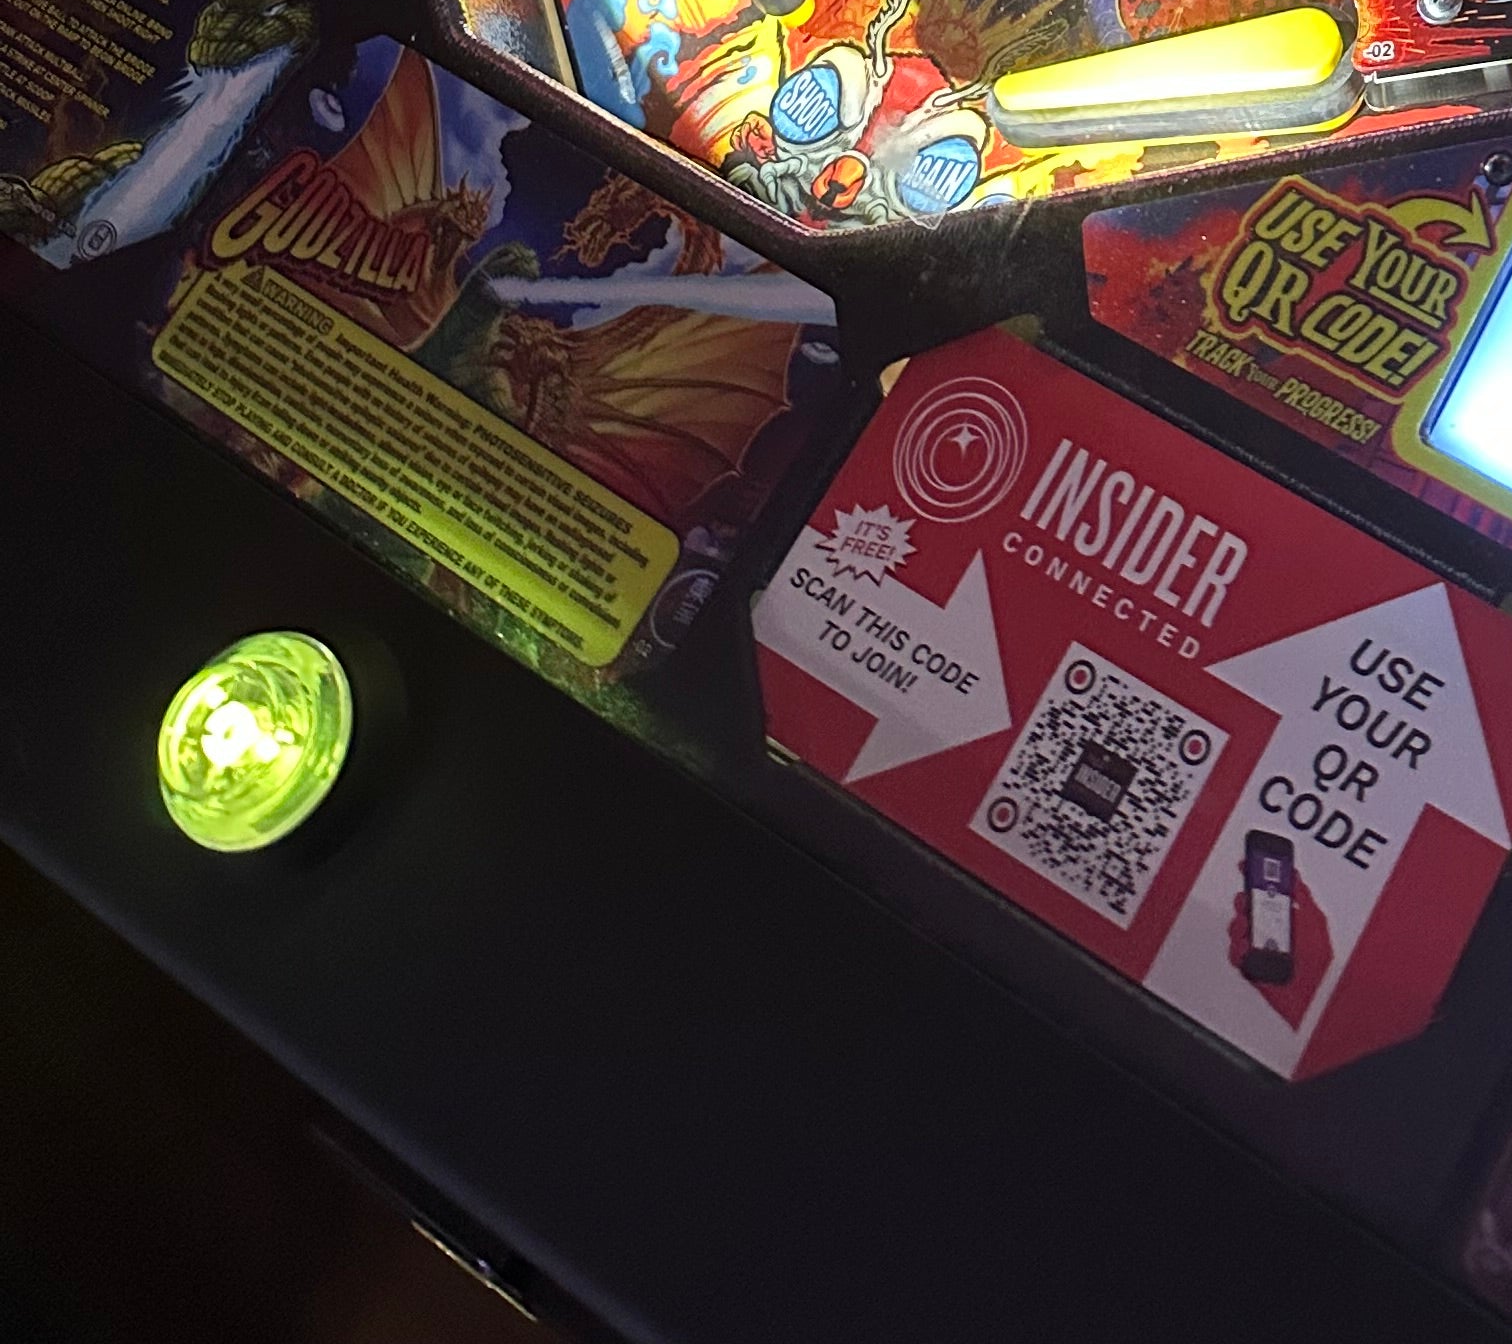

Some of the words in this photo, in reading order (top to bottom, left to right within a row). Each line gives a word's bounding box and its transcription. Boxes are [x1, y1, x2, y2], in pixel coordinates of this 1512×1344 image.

[1366, 44, 1392, 58] -02
[780, 70, 837, 138] SHOOT
[903, 154, 978, 202] AGAIN
[211, 149, 435, 292] GODZILLA
[1254, 193, 1355, 269] USE
[1346, 219, 1458, 320] YOUR
[260, 278, 335, 336] WARNING
[1222, 241, 1308, 337] QR
[1301, 295, 1440, 385] CODE!
[1186, 331, 1250, 376] TRACK
[1275, 377, 1382, 444] PROGRESS!
[334, 332, 389, 375] Important
[386, 365, 426, 399] Health
[472, 420, 574, 499] PHOTOSENSITIVE
[572, 487, 634, 536] SEIZURES
[405, 519, 465, 567] EXPERIENCE
[841, 534, 897, 561] FREE!
[854, 519, 895, 541] IT'S
[1019, 438, 1249, 629] INSIDER
[790, 566, 855, 619] SCAN
[860, 605, 910, 652] THIS
[912, 642, 981, 696] CODE
[1002, 531, 1201, 660] CONNECTED
[824, 620, 852, 653] TO
[853, 639, 919, 694] JOIN!
[1349, 639, 1445, 711] USE
[1310, 675, 1432, 771] YOUR
[1312, 743, 1380, 804] QR
[1258, 776, 1389, 870] CODE
